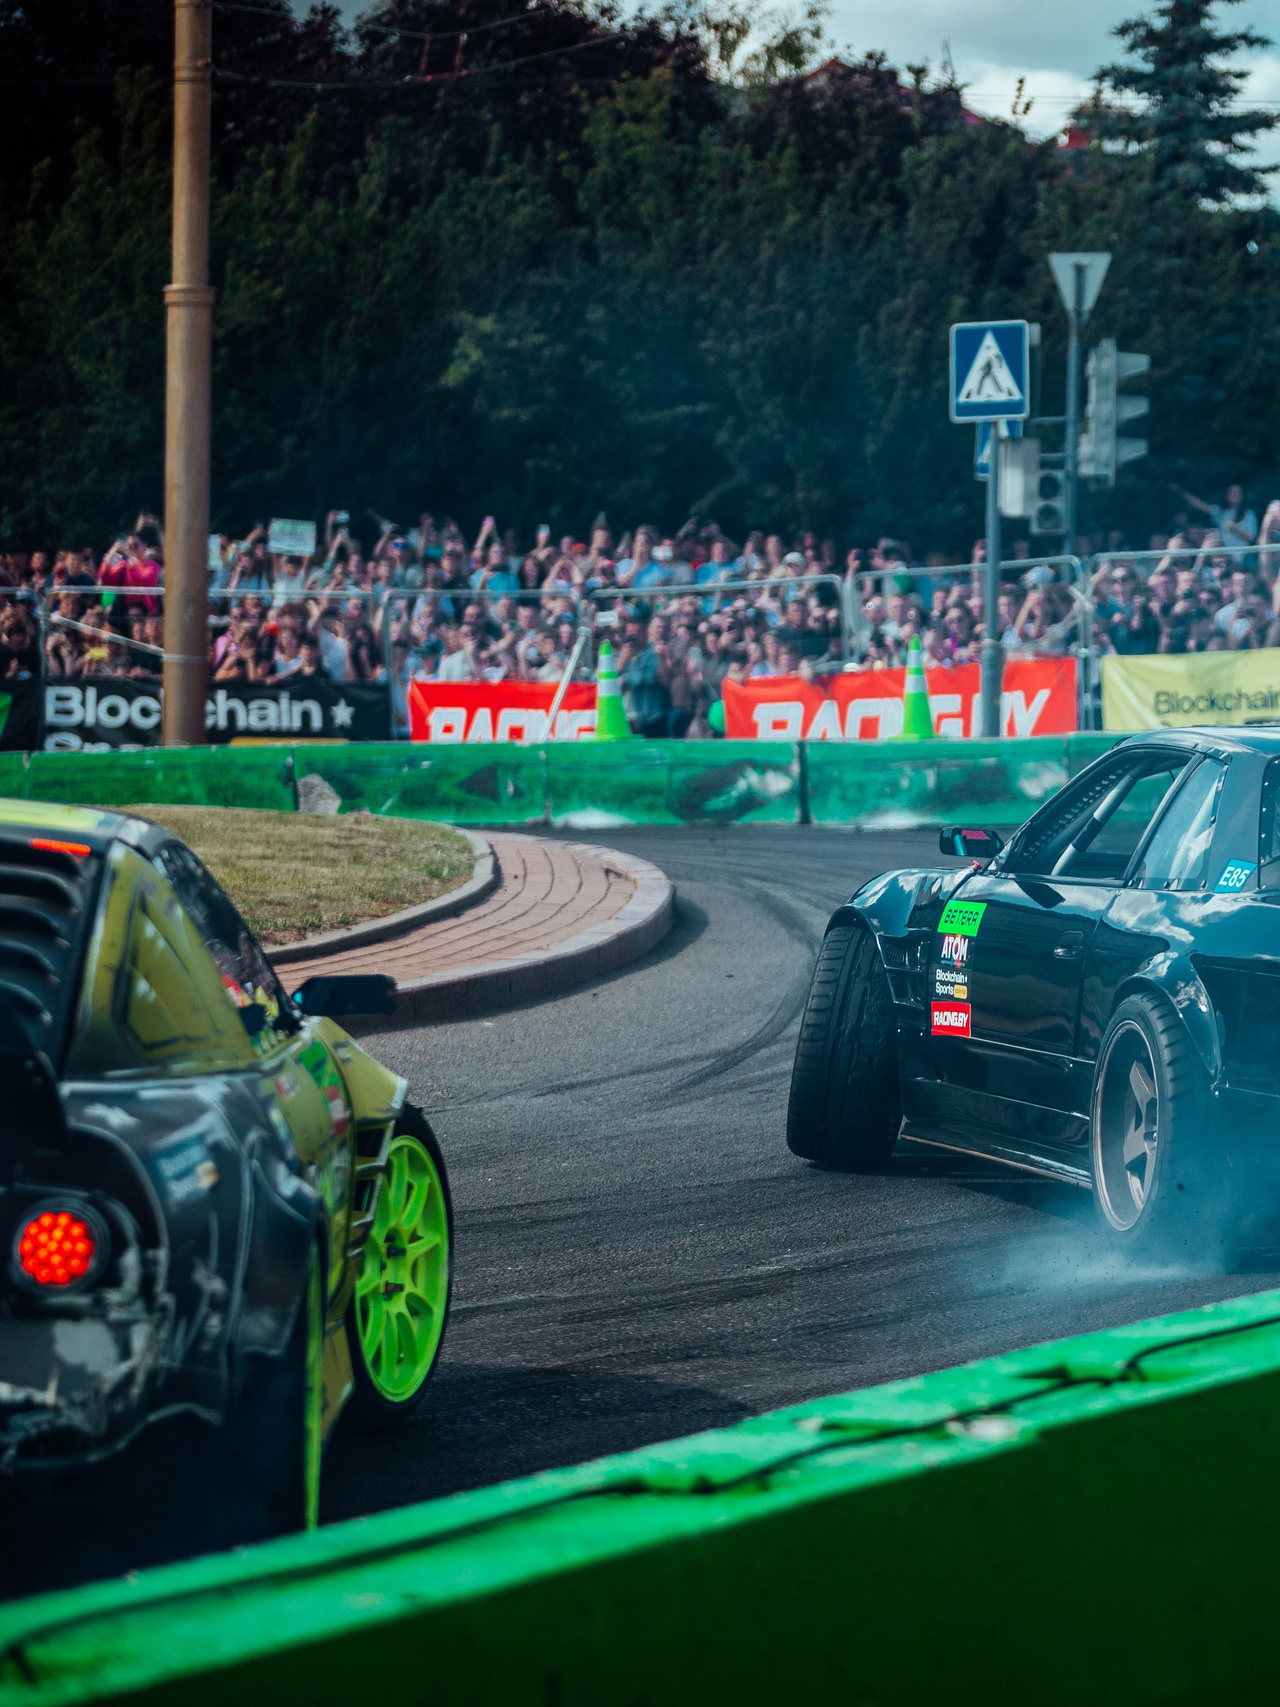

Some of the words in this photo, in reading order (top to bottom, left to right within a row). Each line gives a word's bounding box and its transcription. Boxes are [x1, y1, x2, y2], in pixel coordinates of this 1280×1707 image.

[45, 685, 323, 732] Blochain
[1218, 866, 1251, 888] E85
[941, 936, 969, 961] ATOM
[936, 969, 964, 983] Blockchain
[935, 982, 954, 996] Sports
